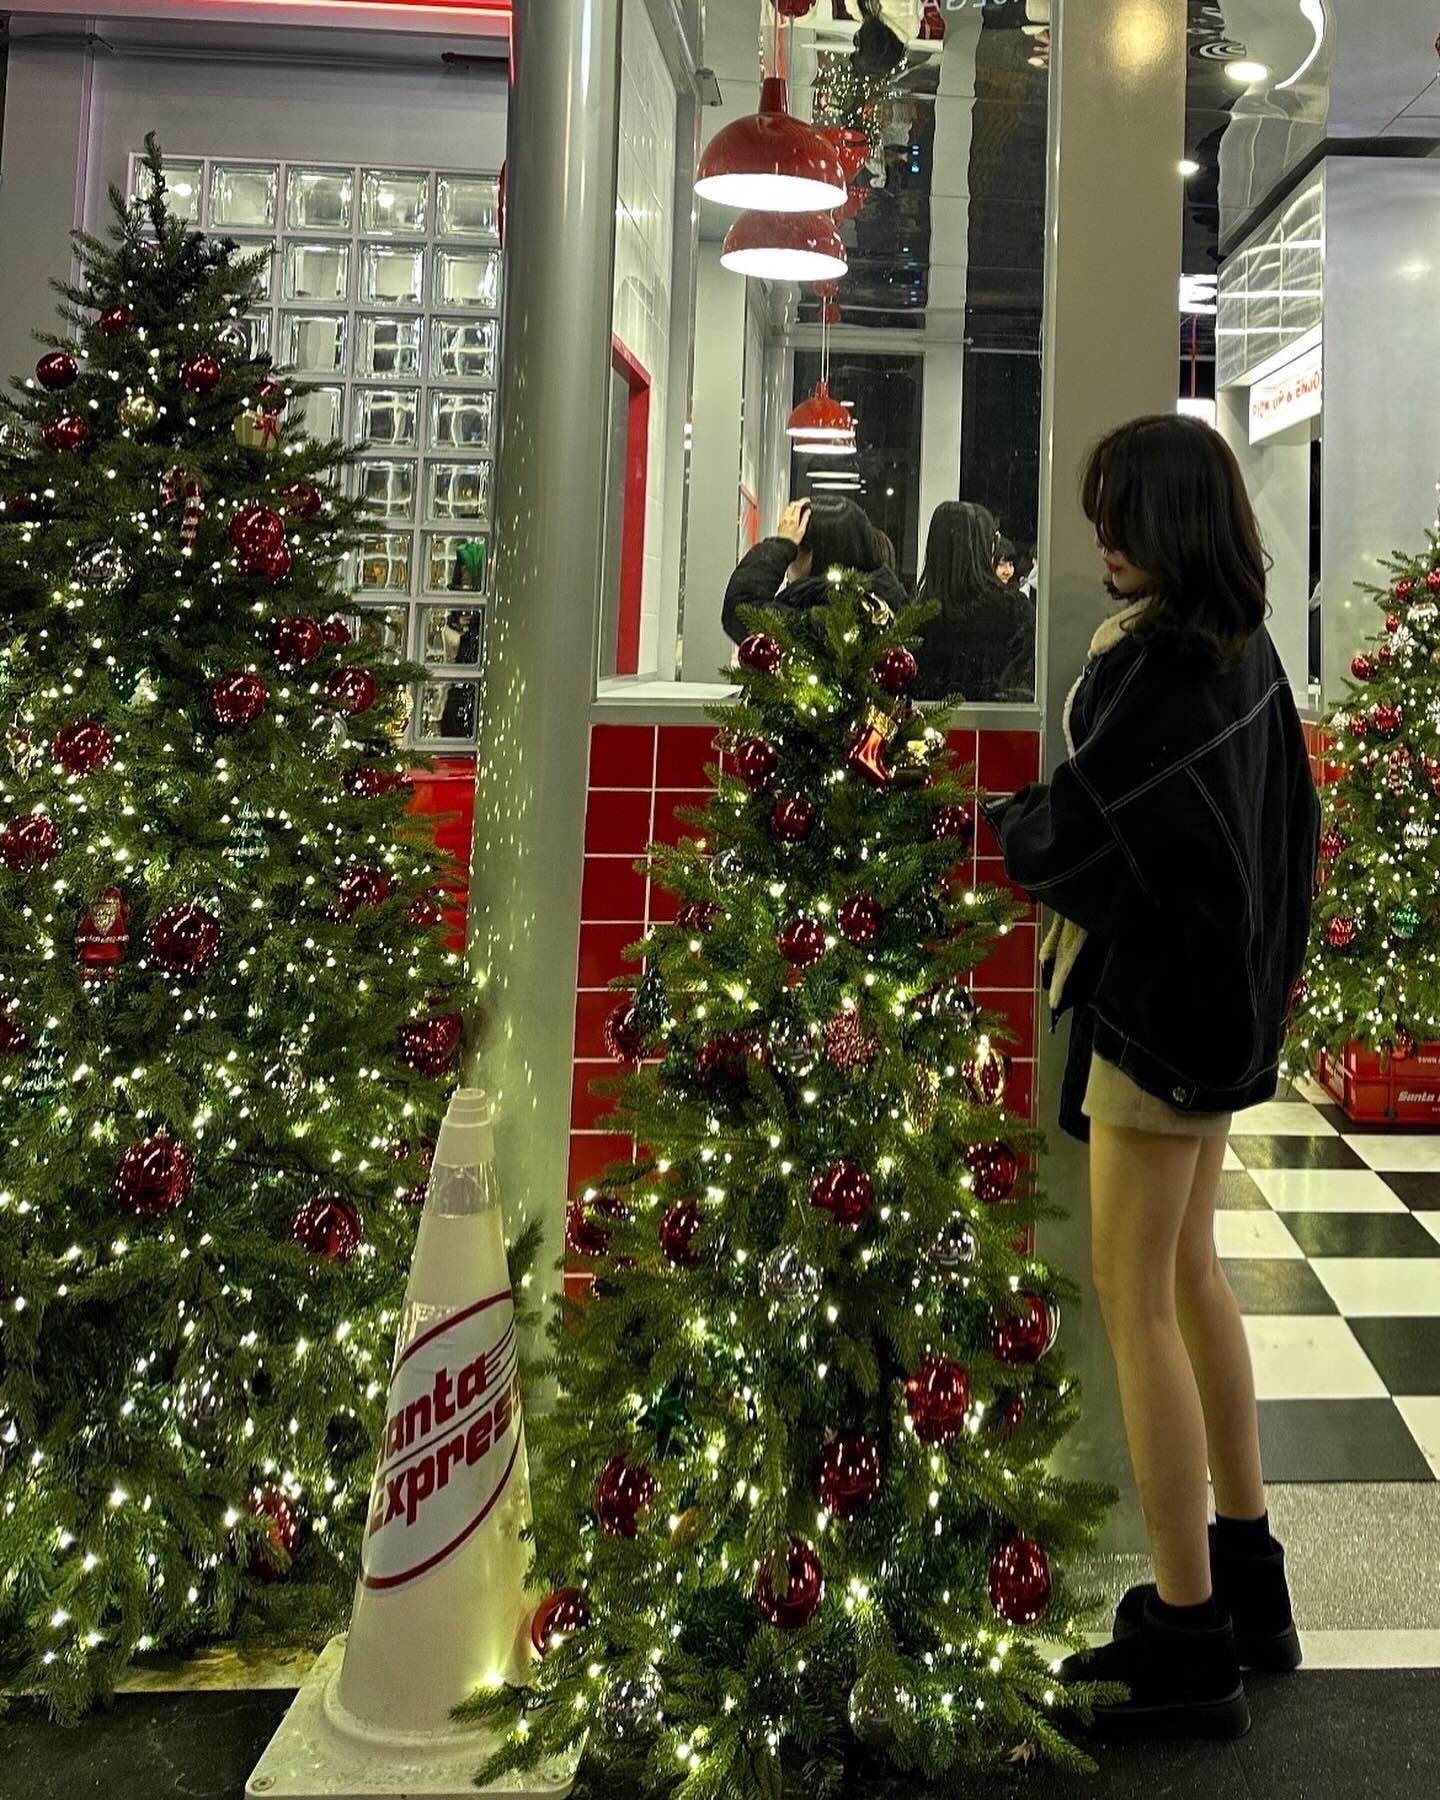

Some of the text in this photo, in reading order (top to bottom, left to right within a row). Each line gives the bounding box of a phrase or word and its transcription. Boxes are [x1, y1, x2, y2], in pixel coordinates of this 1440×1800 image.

[1273, 390, 1285, 411] UP
[1398, 1091, 1435, 1102] Santa
[380, 1351, 488, 1464] anta
